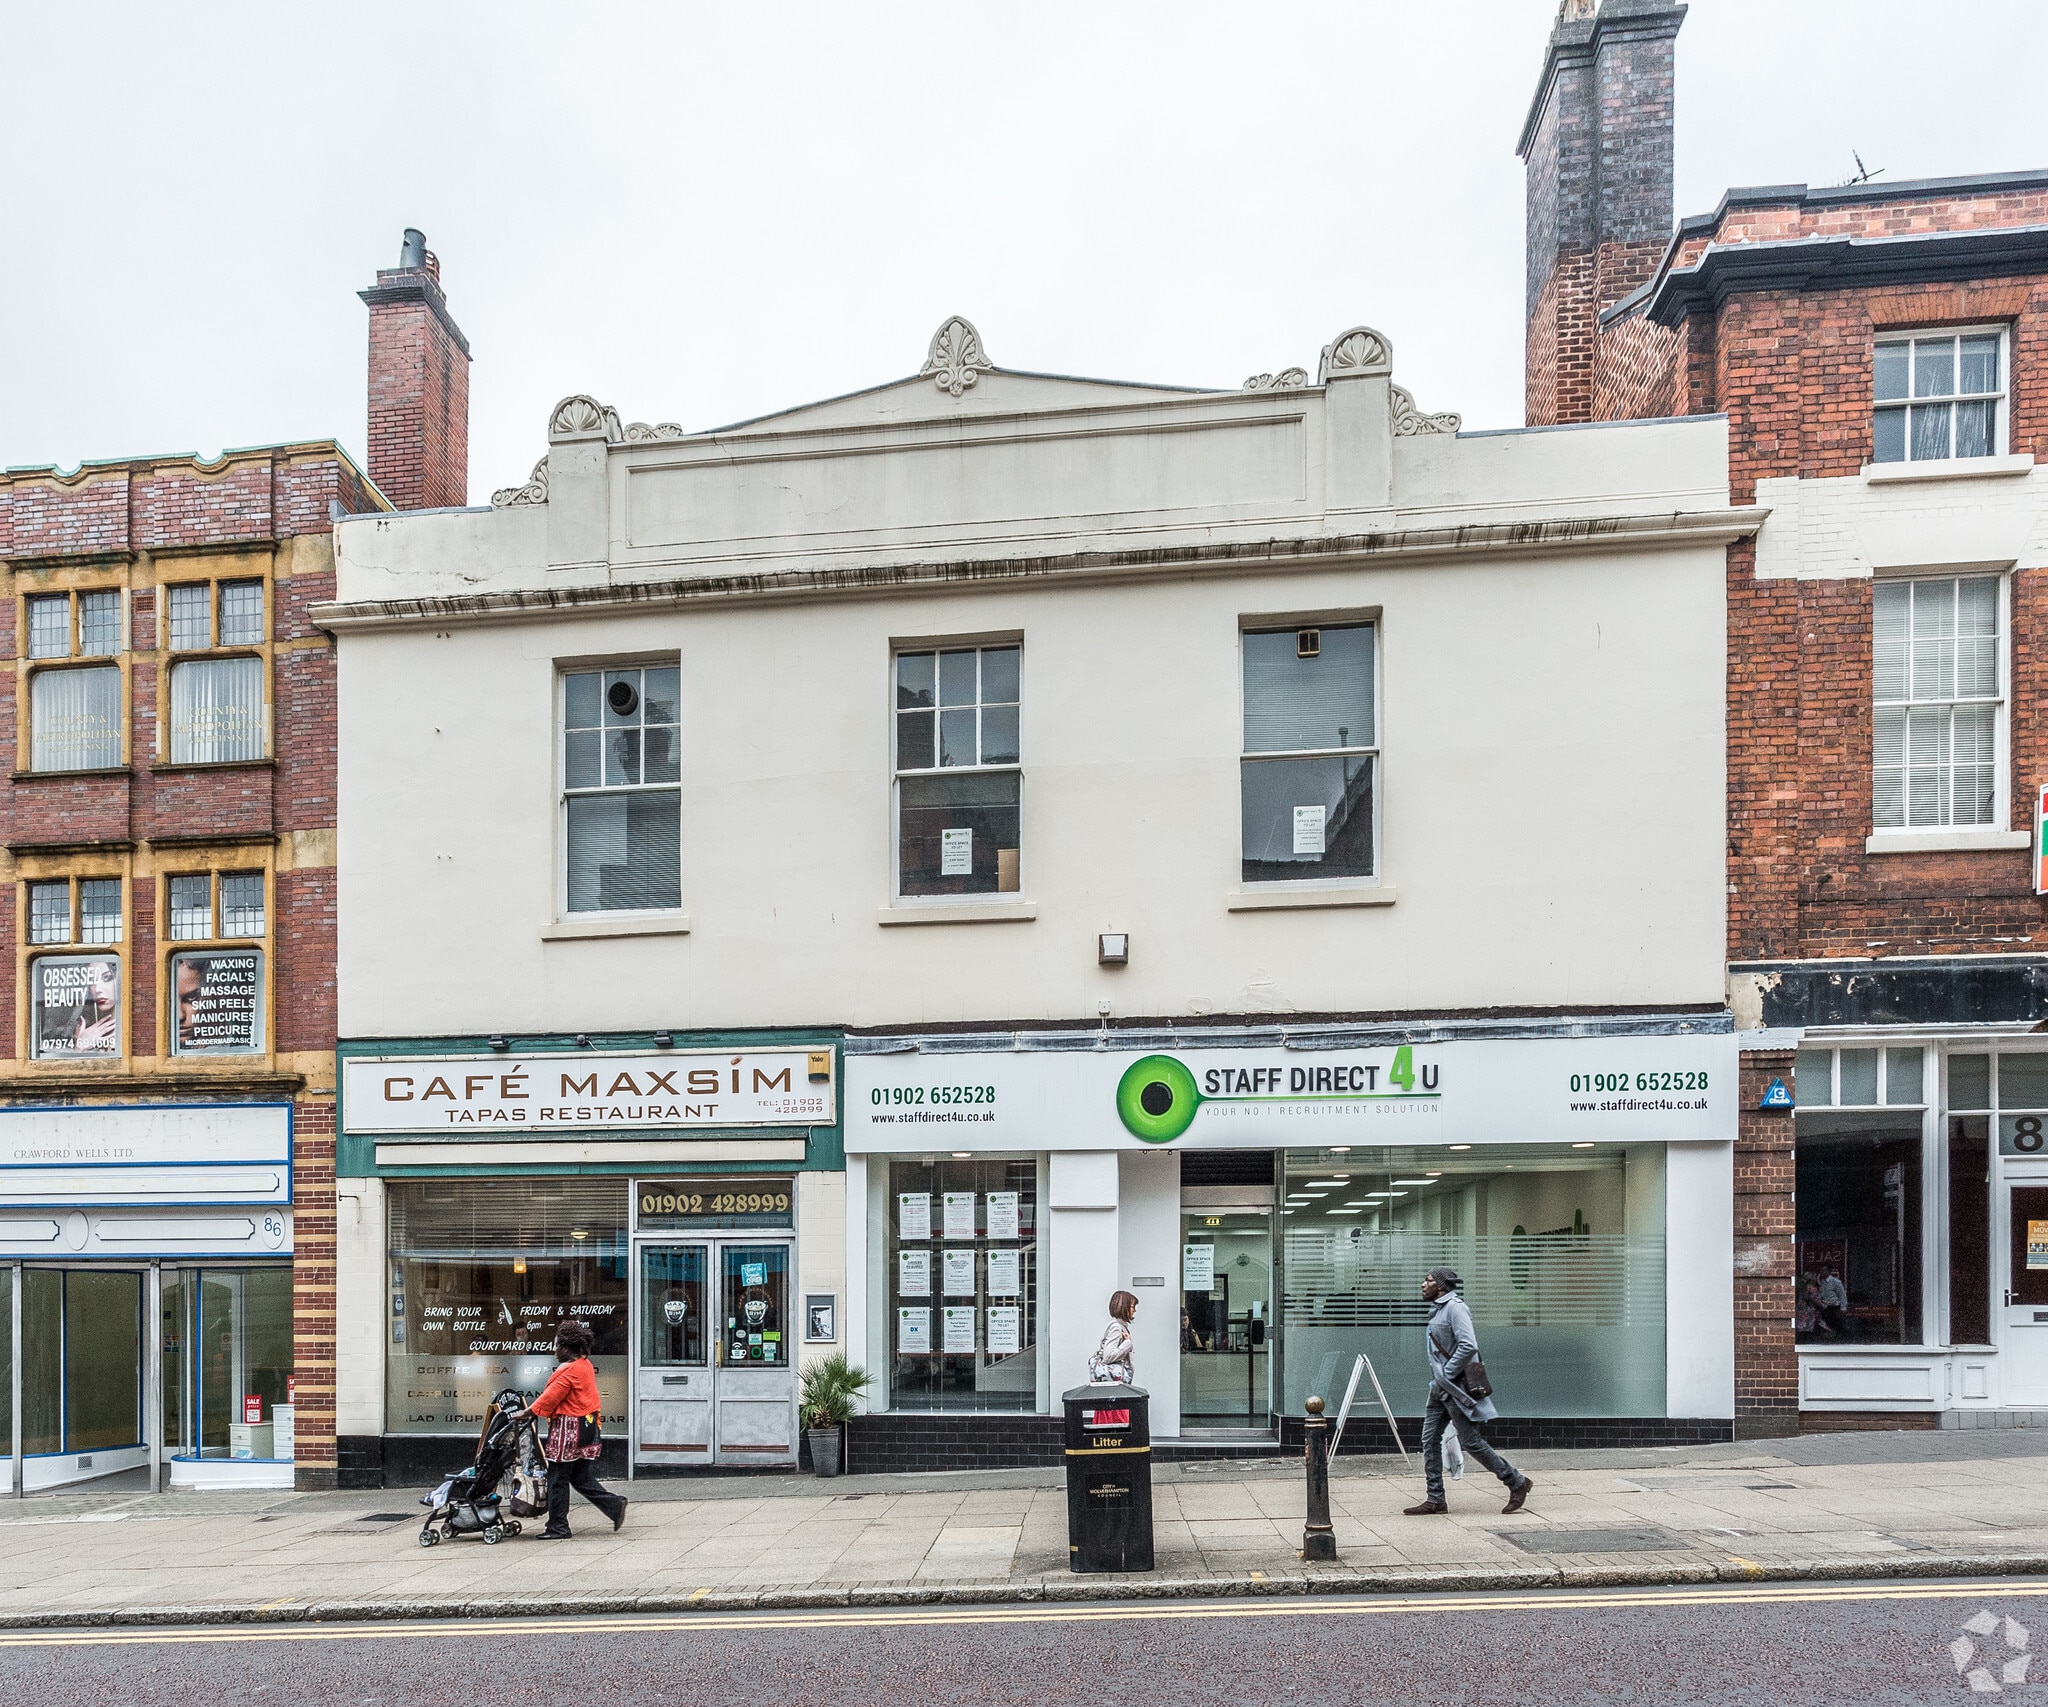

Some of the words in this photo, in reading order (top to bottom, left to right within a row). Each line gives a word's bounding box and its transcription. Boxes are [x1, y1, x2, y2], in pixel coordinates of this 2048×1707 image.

[190, 705, 236, 717] COUNTY
[175, 719, 262, 734] METROPOLITAN
[211, 959, 254, 969] WAXING
[43, 967, 101, 987] OBSESSED
[206, 972, 255, 983] FACIAL'S
[44, 987, 88, 1008] BEAUTY
[201, 986, 255, 997] MASSAGE
[192, 1000, 217, 1011] SKIN
[219, 999, 255, 1009] PEELS
[191, 1012, 254, 1024] MANICURES
[194, 1025, 253, 1037] PEDICURES
[42, 1039, 75, 1049] 07974
[1204, 1068, 1282, 1093] STAFF
[1290, 1065, 1380, 1092] DIRECT
[1389, 1046, 1415, 1090] 4
[1422, 1064, 1439, 1090] U
[384, 1064, 530, 1101] CAFÉ
[1570, 1074, 1630, 1092] 01902
[1636, 1072, 1709, 1090] 652528
[871, 1087, 925, 1105] 01902
[930, 1086, 996, 1104] 652528
[1205, 1108, 1237, 1117] YOUR
[1279, 1106, 1368, 1116] RECRUITMENT
[1375, 1105, 1439, 1114] SOLUTION
[1570, 1098, 1709, 1112] www.staffdirect4u.co.uk
[445, 1108, 526, 1123] TAPAS
[539, 1104, 719, 1121] RESTAURANT
[871, 1110, 996, 1124] www.staffdirect4u.co.uk
[14, 1149, 70, 1159] CRAWFORD
[76, 1149, 109, 1158] WELLS
[642, 1194, 703, 1213] 01902
[711, 1194, 789, 1213] 428999
[264, 1218, 282, 1237] 86
[424, 1307, 453, 1317] BRING
[456, 1307, 483, 1317] YOUR
[519, 1306, 552, 1316] FRIDAY
[557, 1307, 565, 1316] &
[569, 1305, 616, 1316] SATURDAY
[422, 1322, 445, 1331] OWN
[453, 1322, 487, 1331] BOTTLE
[526, 1321, 542, 1332] 6pm
[417, 1367, 470, 1375] COFFEE
[485, 1367, 510, 1375] TEA
[1092, 1438, 1123, 1448] Litter
